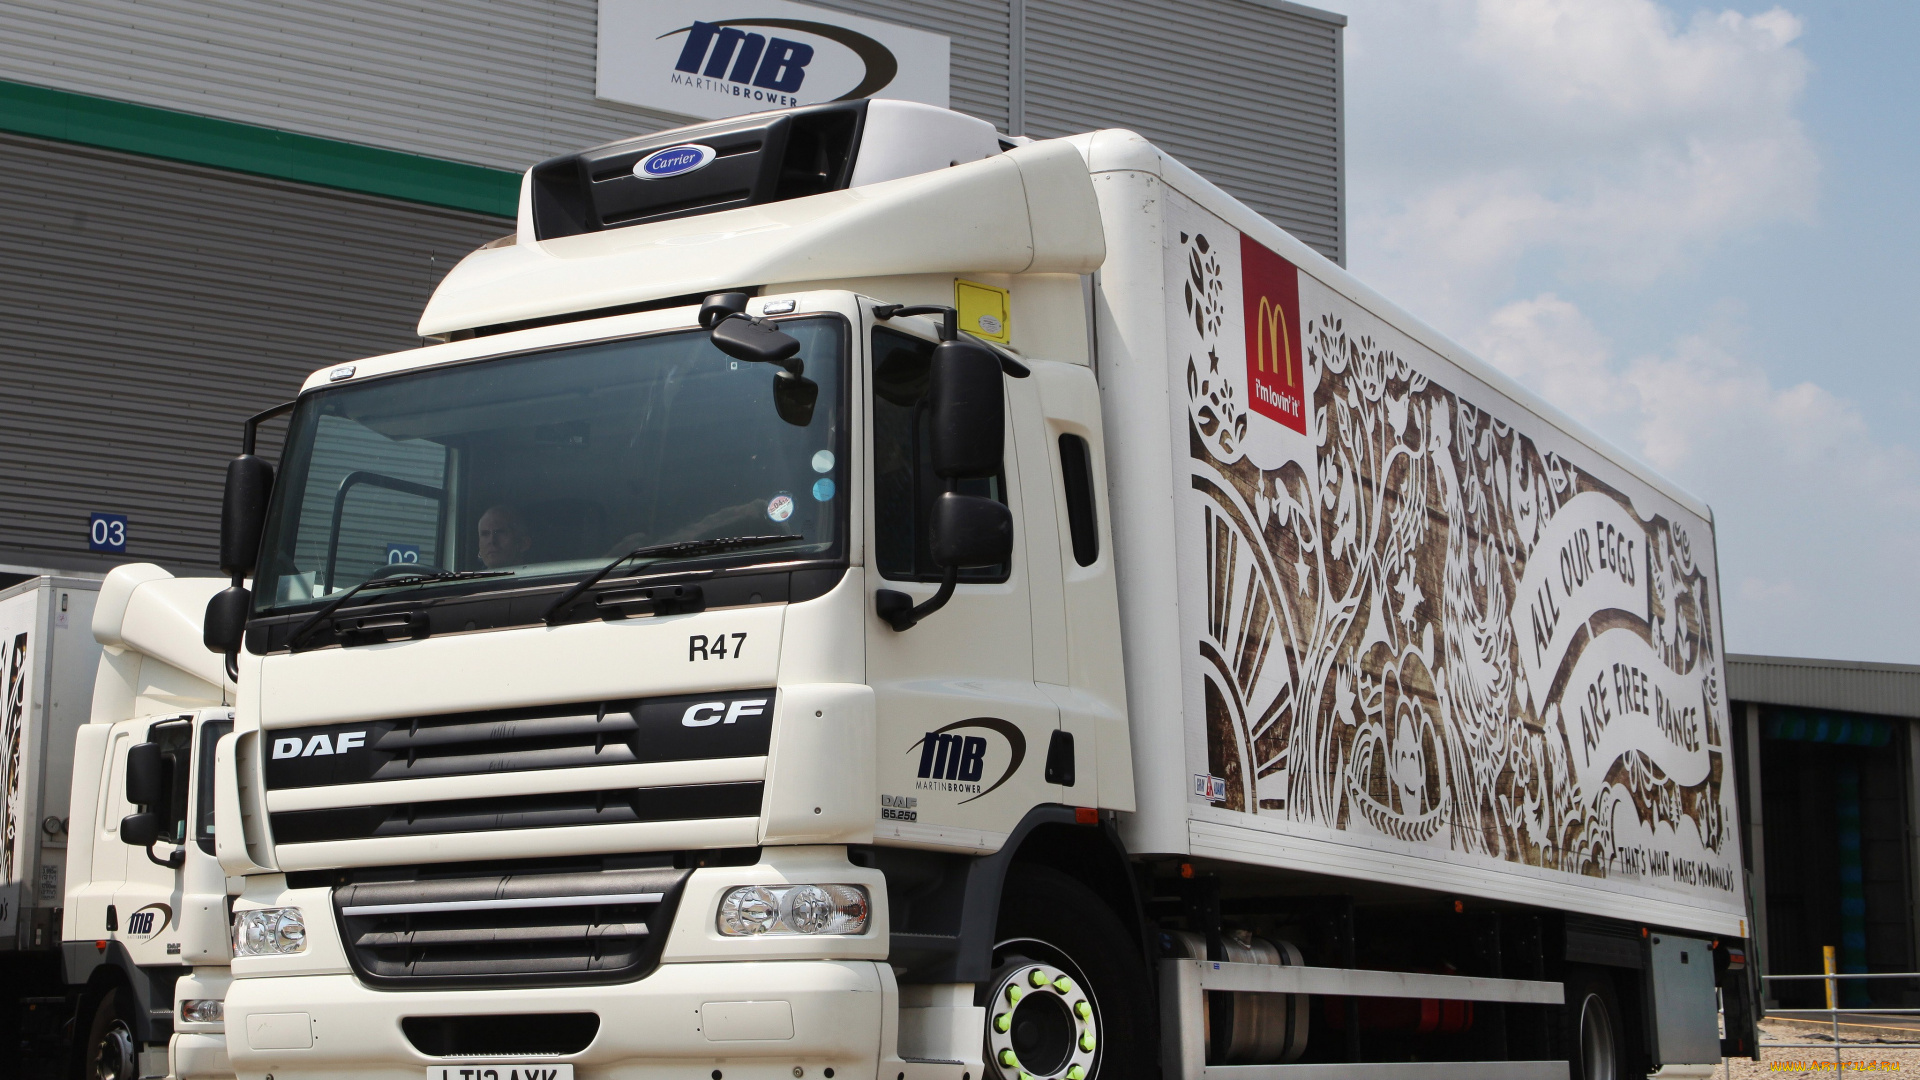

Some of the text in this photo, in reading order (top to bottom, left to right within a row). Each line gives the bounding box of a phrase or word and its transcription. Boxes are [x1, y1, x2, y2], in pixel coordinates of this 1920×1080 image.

[674, 20, 814, 93] MB
[670, 73, 797, 107] MARTINBROWER
[652, 153, 696, 170] Carrier
[1255, 378, 1269, 403] i'm
[1269, 385, 1291, 413] lovin'
[92, 519, 125, 546] 03
[1531, 521, 1635, 669] ALL OUR EGGS
[689, 632, 747, 661] R47
[681, 699, 767, 727] CF
[1580, 662, 1700, 768] ARE FREE RANGE
[272, 731, 367, 759] DAF
[917, 732, 987, 782] MB
[881, 794, 918, 809] DAF
[915, 781, 981, 794] MARTINBROWER
[882, 808, 917, 822] 65.250
[1618, 844, 1646, 875] THAT'S
[1648, 848, 1669, 878] WHAT
[1672, 857, 1697, 886] MAKES
[128, 912, 154, 934] MB
